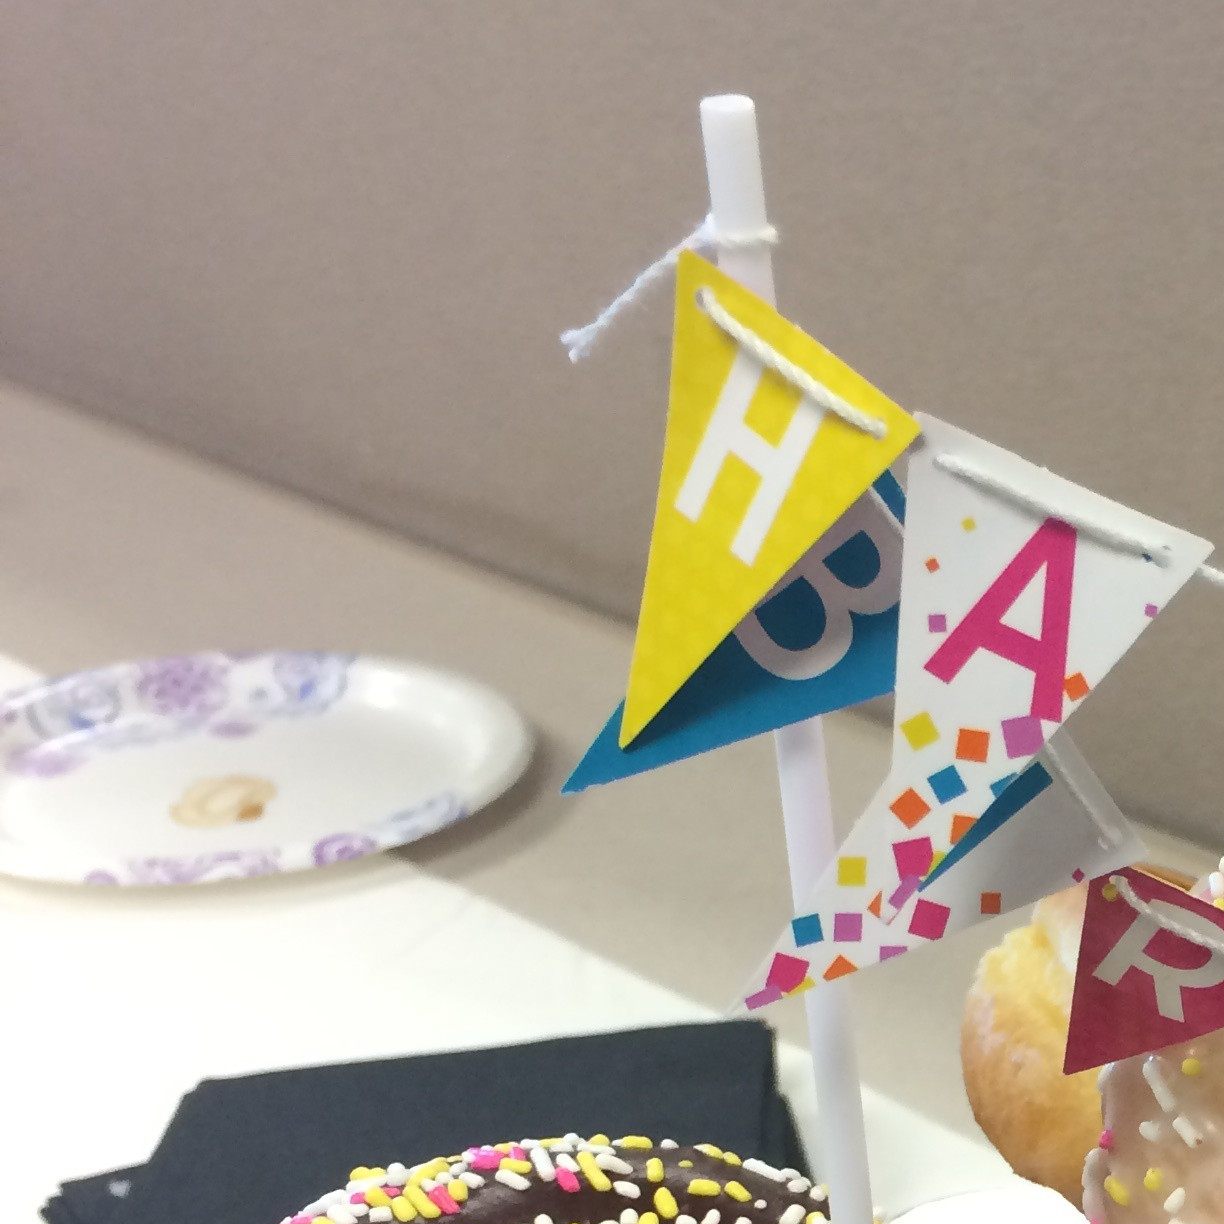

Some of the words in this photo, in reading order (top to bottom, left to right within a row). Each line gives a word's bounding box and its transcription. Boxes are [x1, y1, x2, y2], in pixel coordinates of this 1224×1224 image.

[673, 345, 828, 567] H
[731, 487, 904, 681] B
[923, 516, 1078, 722] A
